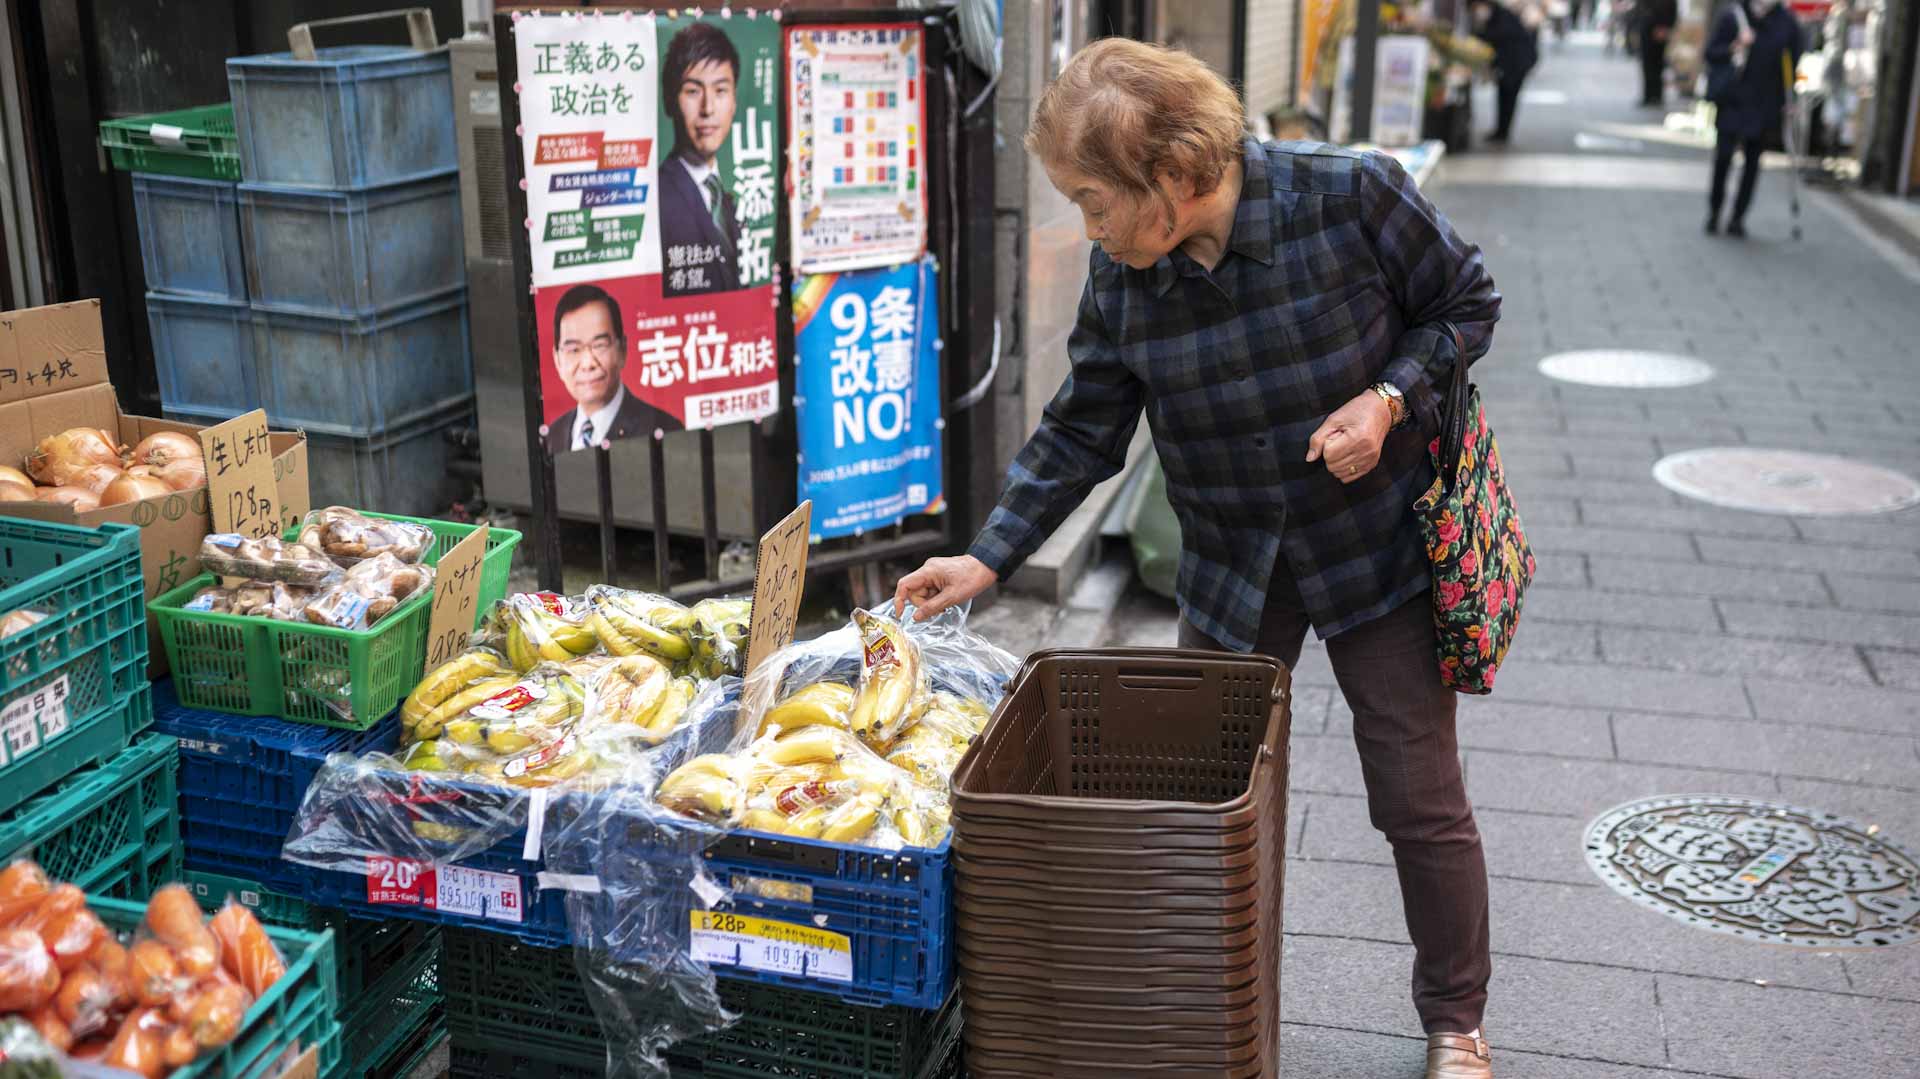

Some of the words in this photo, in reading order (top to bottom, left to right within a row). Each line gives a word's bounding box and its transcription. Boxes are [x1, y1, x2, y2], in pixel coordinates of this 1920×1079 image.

[533, 41, 645, 75] 正義ある
[549, 83, 633, 116] 政治を
[585, 188, 643, 205] ジェンダー平等
[732, 107, 775, 285] 山添拓
[668, 244, 727, 269] 憲法が、
[670, 267, 712, 290] 希望。
[830, 286, 915, 347] 9条
[638, 325, 775, 388] 志位和夫
[830, 338, 914, 398] 改憲
[699, 388, 770, 418] 日本共産党
[833, 388, 912, 449] NO!
